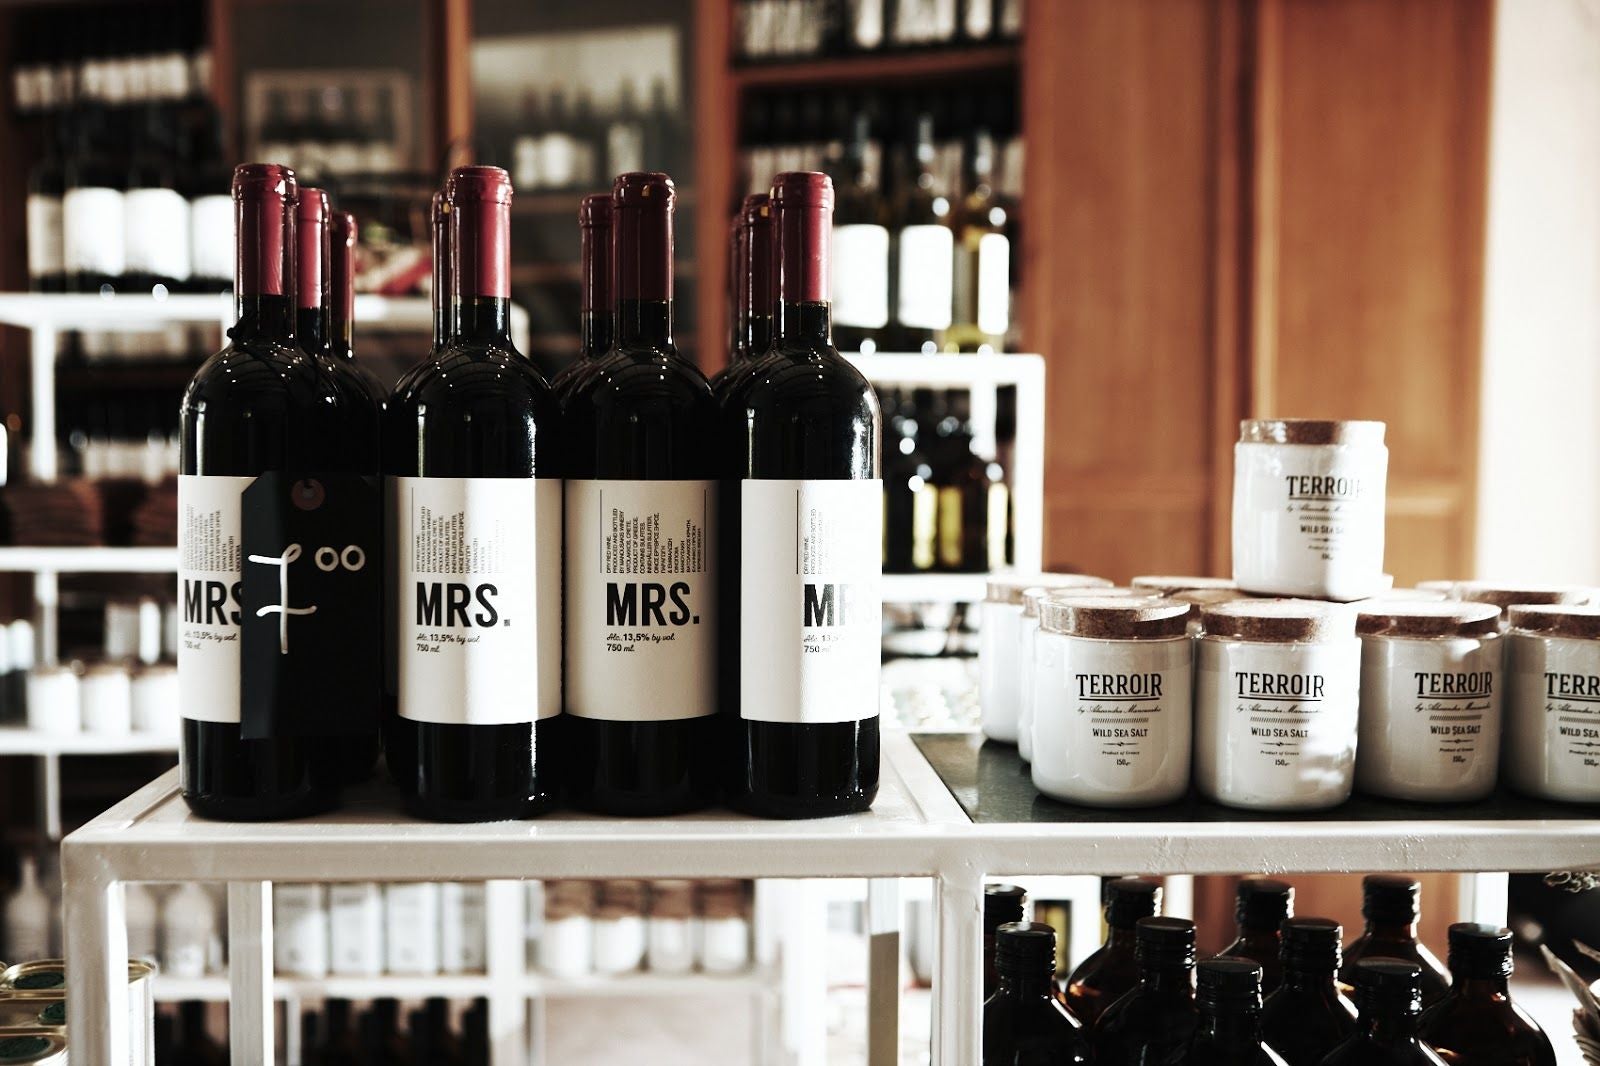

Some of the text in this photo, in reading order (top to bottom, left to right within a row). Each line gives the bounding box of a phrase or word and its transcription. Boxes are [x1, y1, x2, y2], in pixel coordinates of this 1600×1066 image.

[417, 582, 510, 627] MRS.
[607, 582, 700, 626] MRS.
[456, 635, 465, 645] by
[623, 633, 650, 642] 13,5%
[651, 634, 661, 643] by
[416, 644, 428, 652] 750
[607, 644, 622, 652] 750
[804, 645, 820, 653] 750
[1076, 674, 1162, 696] TERROIR
[1235, 672, 1324, 697] TERROIR
[1415, 672, 1492, 694] TERROIR
[1544, 672, 1600, 695] TERR
[1093, 728, 1148, 737] WILD SEA SALT
[1251, 727, 1308, 738] WILD SEA SALT
[1430, 725, 1481, 735] WILD SEA SALT
[1560, 727, 1599, 738] WILD SEA
